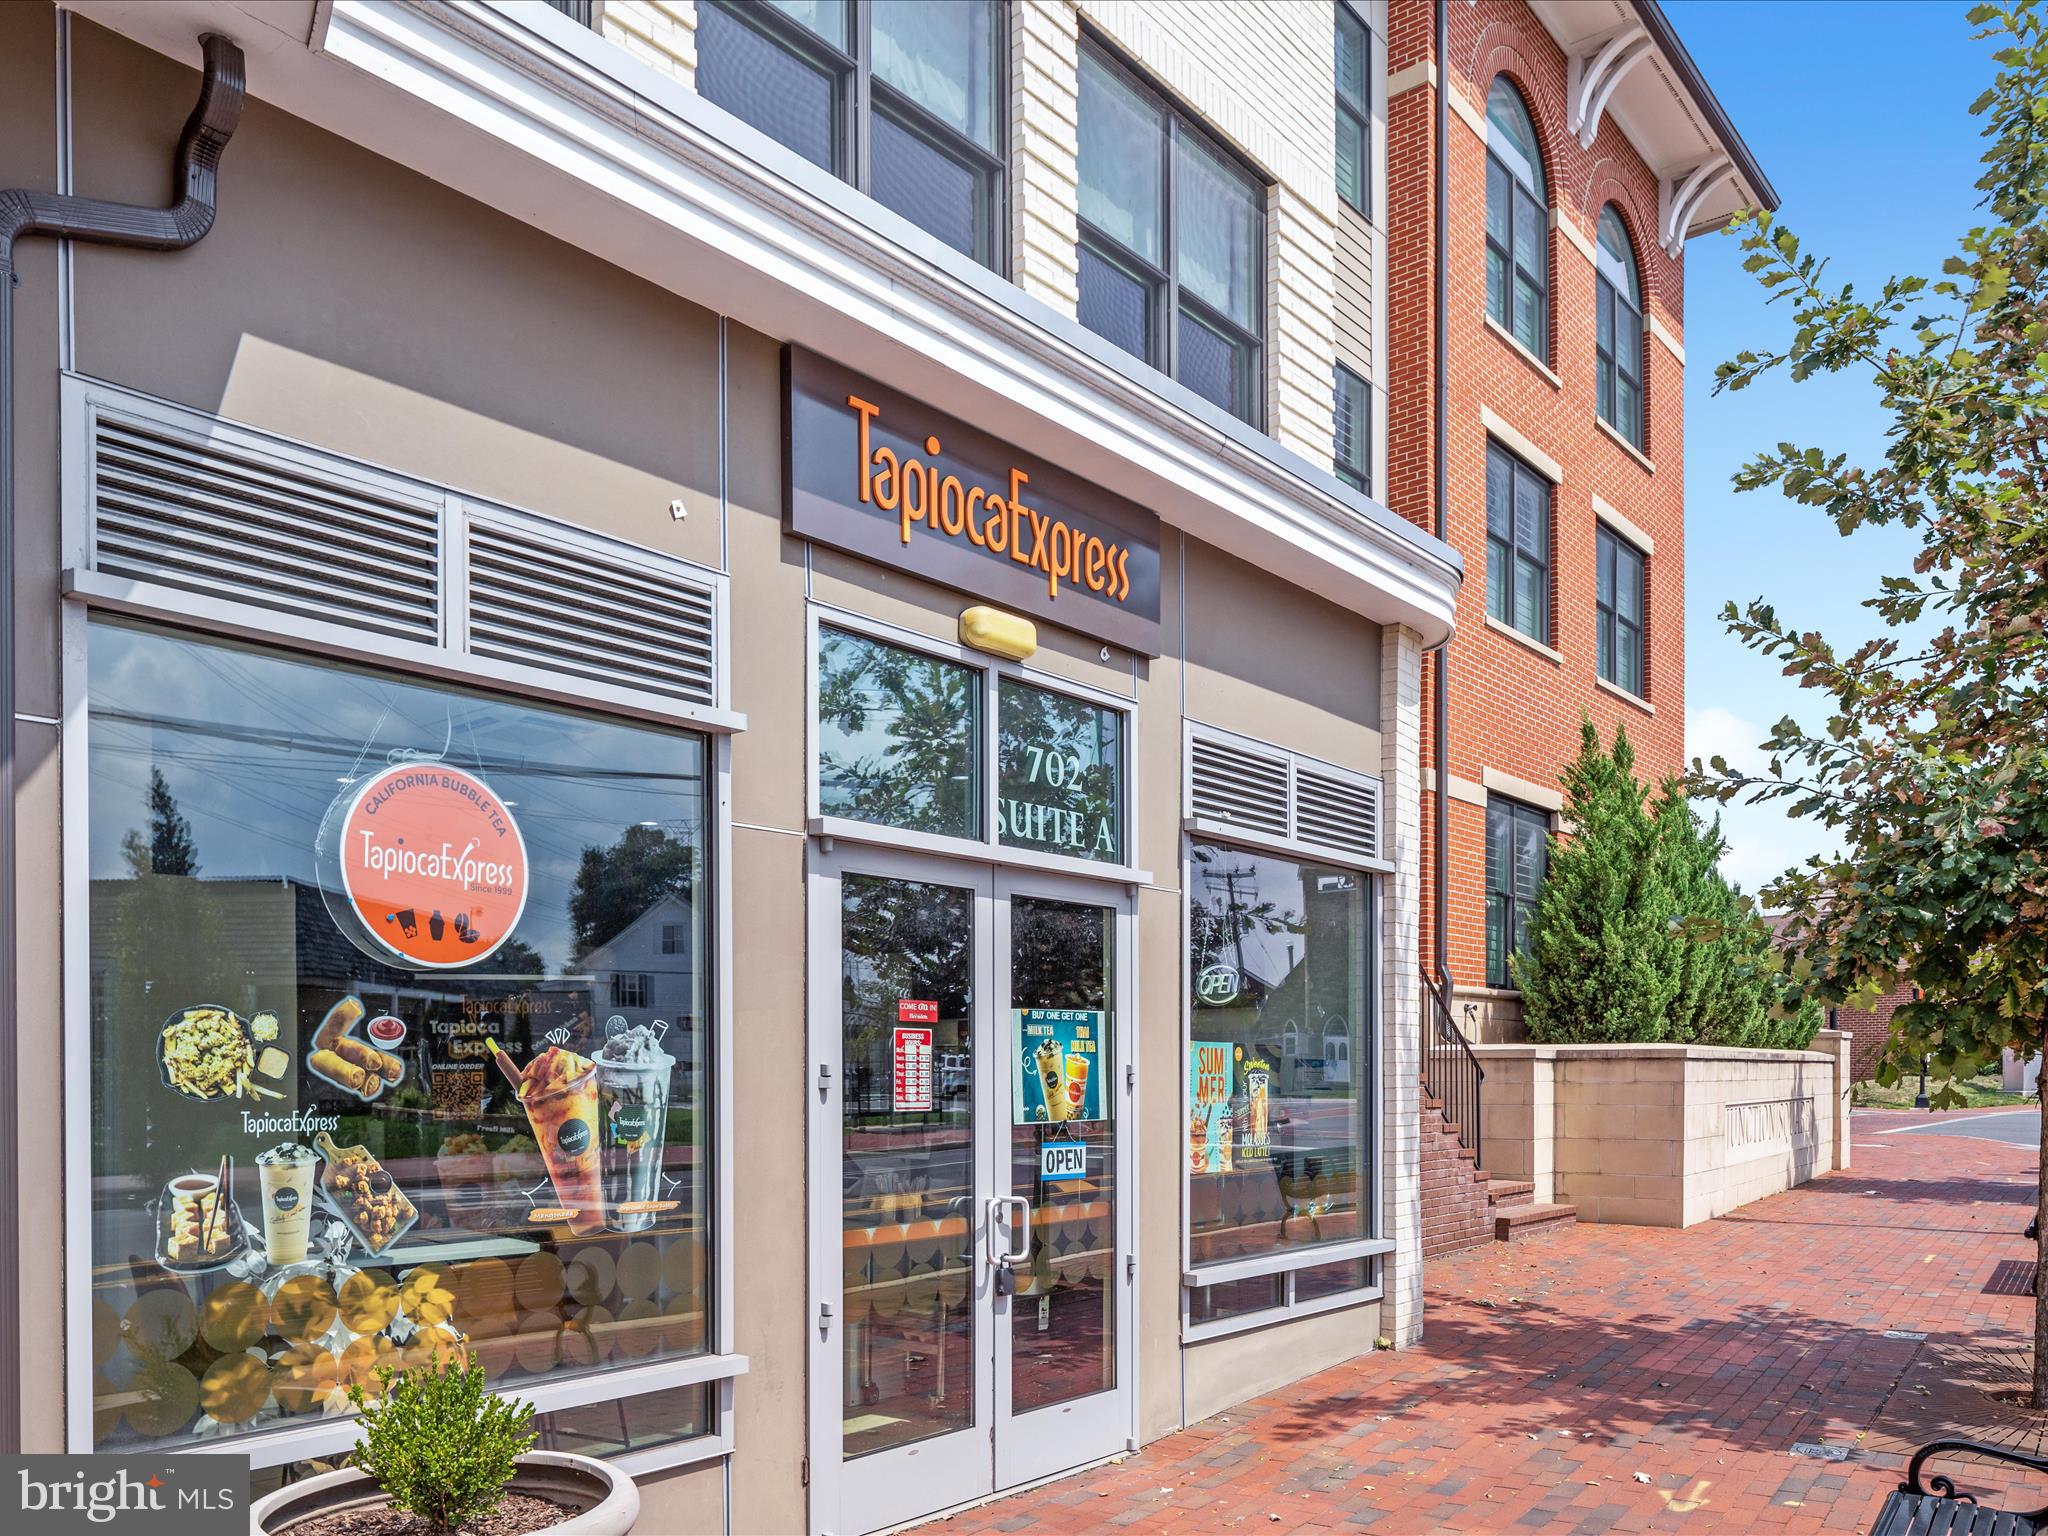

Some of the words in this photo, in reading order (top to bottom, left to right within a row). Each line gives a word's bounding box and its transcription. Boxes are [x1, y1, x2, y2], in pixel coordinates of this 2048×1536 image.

[847, 394, 1130, 602] TapiocaExpress
[1026, 745, 1083, 791] 702
[364, 774, 438, 815] CALIFORNIA
[441, 777, 491, 813] BUBBLE
[488, 809, 507, 838] TEA
[1094, 816, 1115, 852] A
[359, 830, 513, 891] TapiocaExpress
[470, 883, 492, 894] Since
[495, 886, 513, 896] 1999
[1199, 973, 1239, 995] OPEN
[429, 1020, 500, 1038] Tapioca
[1031, 1010, 1044, 1019] BUY
[1046, 1011, 1060, 1020] ONE
[1061, 1012, 1074, 1021] GET
[1075, 1012, 1088, 1021] ONE
[1043, 1025, 1054, 1036] TEA
[1198, 1047, 1224, 1075] SUM
[1198, 1075, 1226, 1103] MER
[240, 1104, 339, 1138] TapiocaExpress
[1046, 1148, 1083, 1174] OPEN
